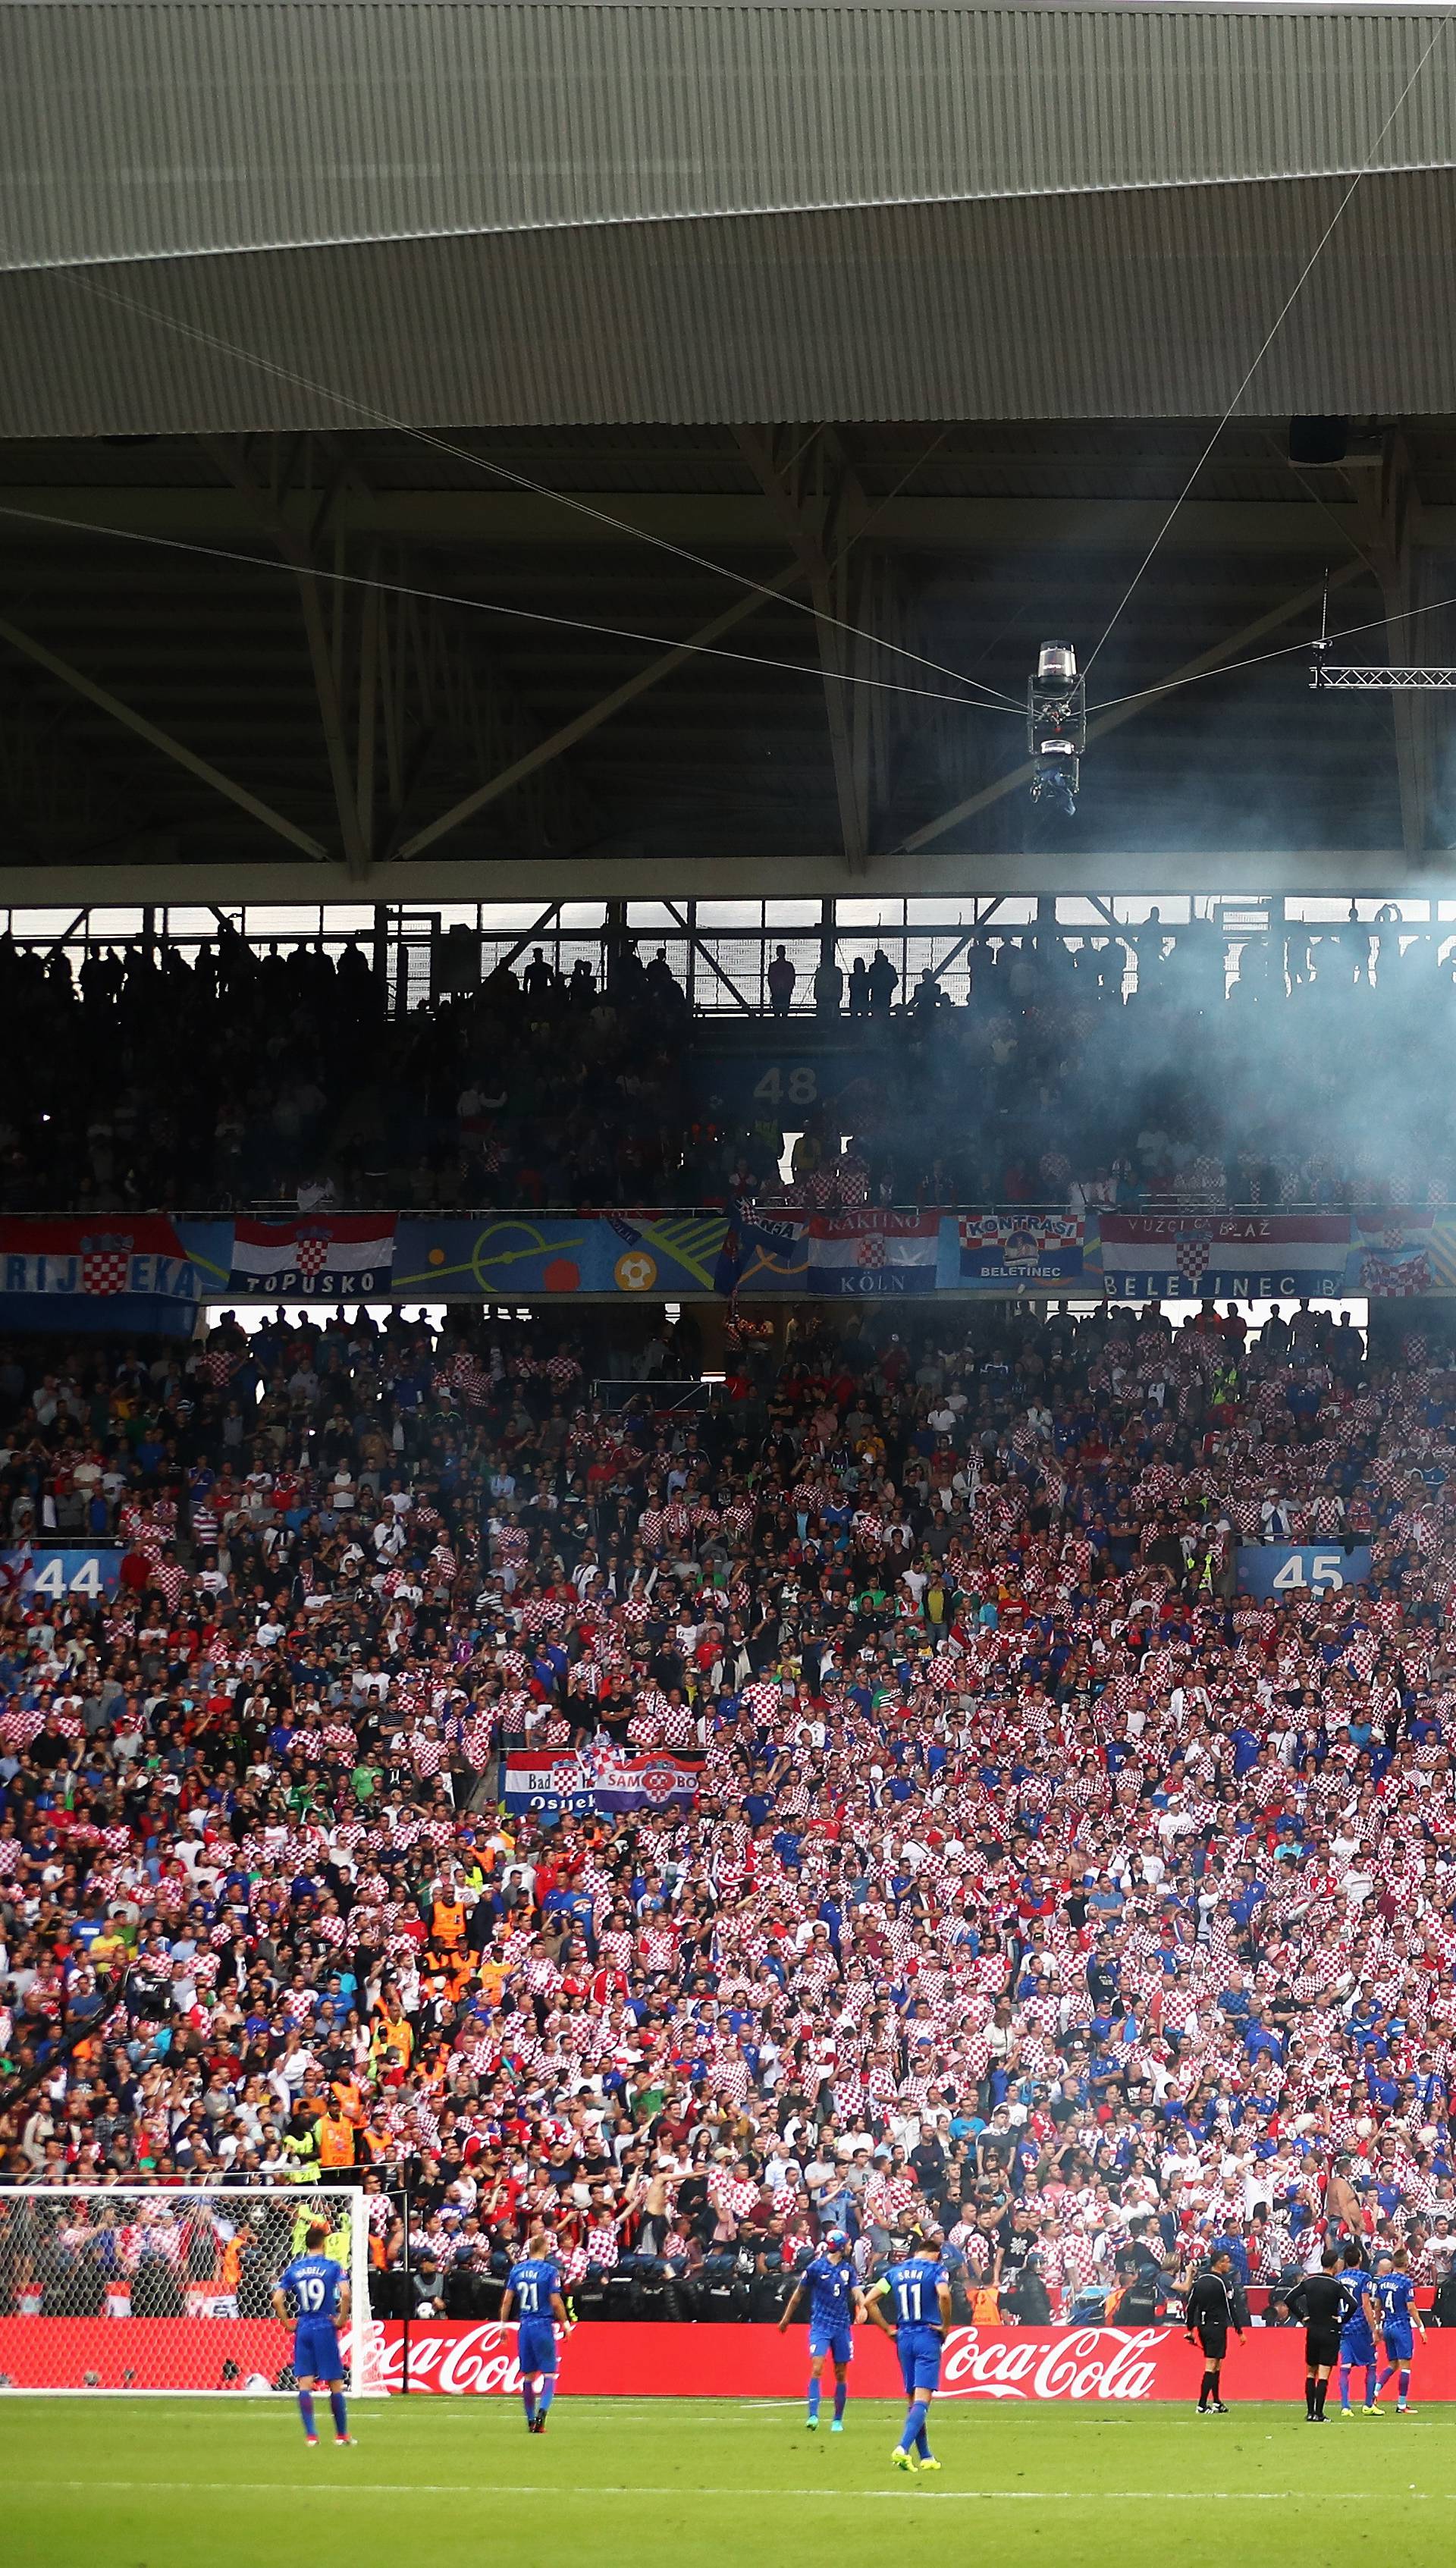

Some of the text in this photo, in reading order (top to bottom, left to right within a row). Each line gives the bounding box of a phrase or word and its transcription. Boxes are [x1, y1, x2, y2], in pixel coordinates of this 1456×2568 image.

[753, 1067, 817, 1105] 48
[246, 1273, 375, 1294] TOPUSKO
[840, 1270, 905, 1293] KÖLN
[981, 1267, 1062, 1277] BELETINEC
[1103, 1276, 1295, 1296] BELETINEC
[35, 1559, 103, 1599] 44
[1273, 1556, 1344, 1596] 45
[529, 1773, 551, 1790] Bad
[897, 2270, 923, 2281] SRNA
[297, 2278, 325, 2312] 19
[516, 2281, 538, 2312] 21
[833, 2283, 840, 2297] 5
[898, 2283, 921, 2321] 11
[1385, 2291, 1395, 2313] 4
[338, 2321, 576, 2393] Coca-Co
[941, 2327, 1171, 2398] Coca-Cola
